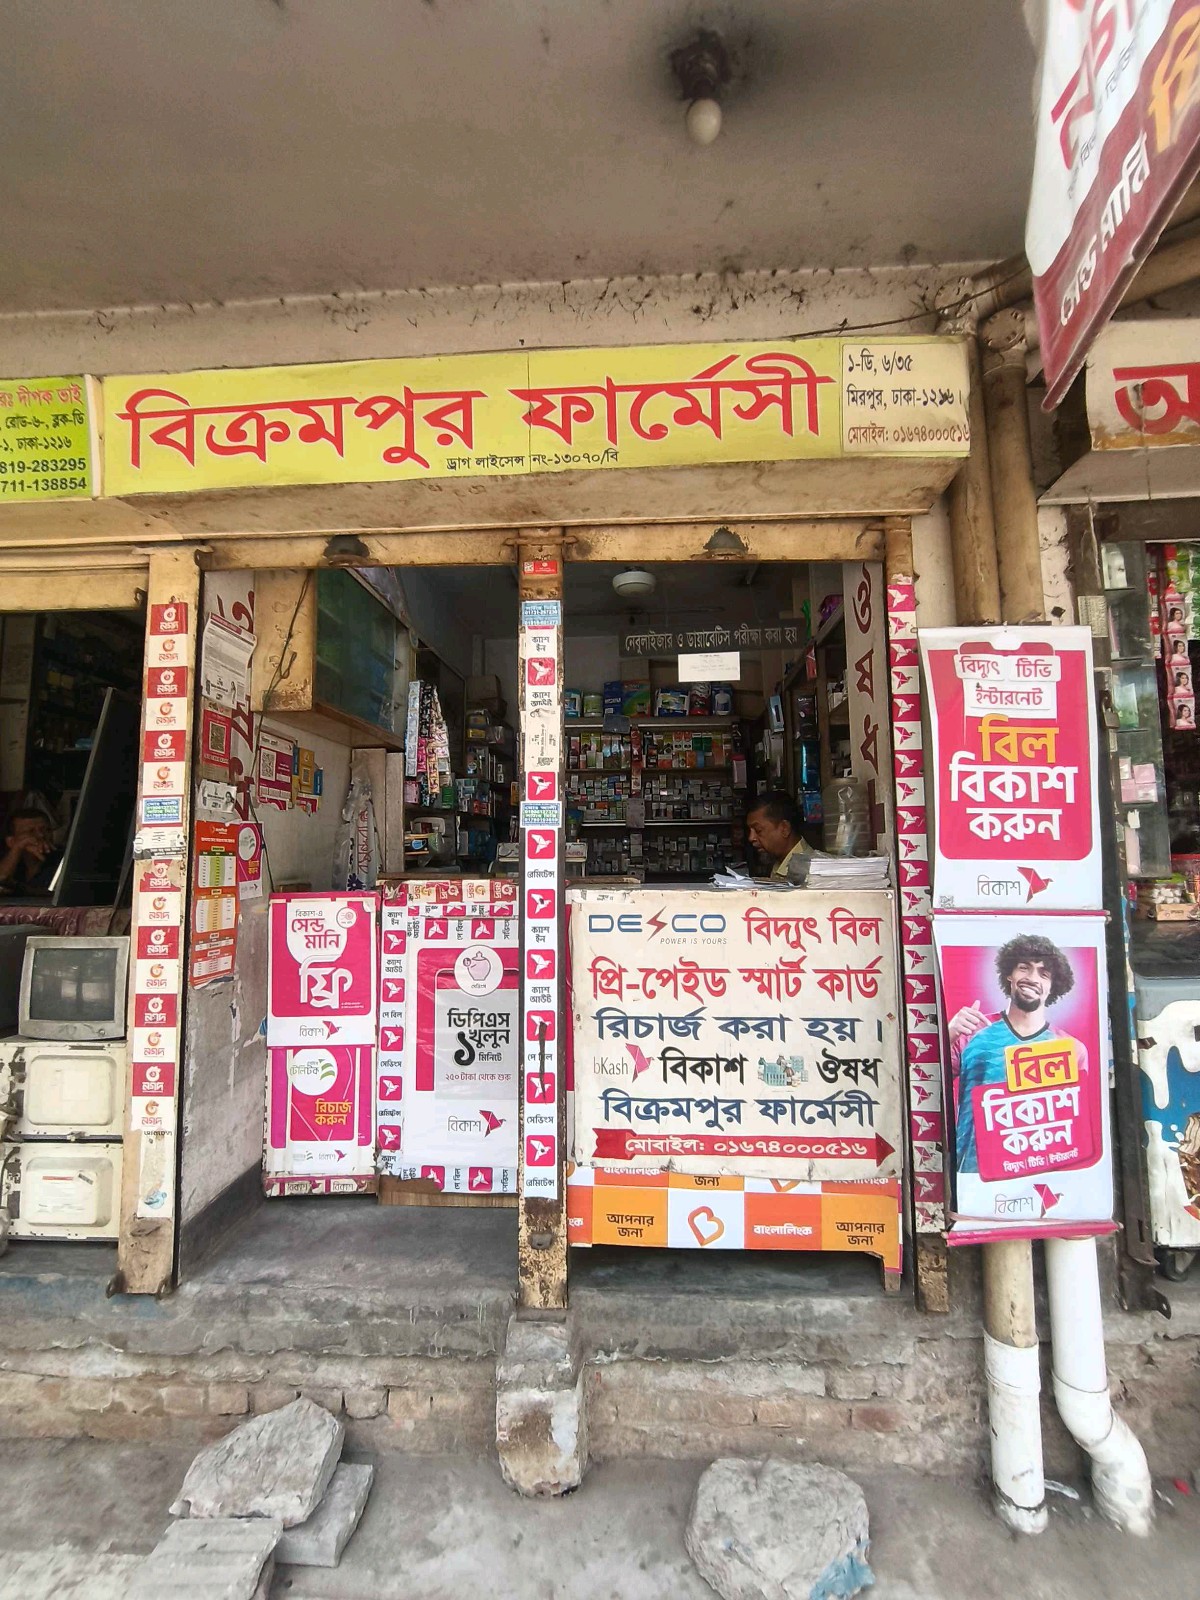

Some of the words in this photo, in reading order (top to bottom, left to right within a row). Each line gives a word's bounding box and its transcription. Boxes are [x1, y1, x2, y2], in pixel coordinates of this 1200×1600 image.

[847, 383, 887, 410] মিরপুর,
[116, 386, 488, 469] বিক্রমপুর
[509, 353, 836, 446] ফার্মেসী
[446, 457, 471, 471] ড্রাগ
[475, 454, 525, 470] লাইসেন্স
[625, 630, 673, 655] নেবুলাইজার
[677, 635, 684, 648] ও
[686, 625, 730, 649] ডায়াবেটিস
[734, 623, 761, 647] পরীক্ষা
[765, 628, 782, 644] করা
[785, 627, 797, 644] হয়
[959, 656, 1001, 679] বিদ্যুৎ
[1015, 657, 1053, 678] টিভি
[975, 686, 1044, 706] ইন্টারনেট
[977, 714, 1060, 763] বিল
[948, 751, 1079, 804] বিকাশ
[966, 807, 1062, 843] করুন
[976, 874, 1021, 896] বিকাশ
[292, 918, 325, 933] সেন্ড
[742, 907, 822, 952] বিদ্যুৎ
[826, 907, 883, 945] বিল
[304, 929, 341, 949] মানি
[535, 934, 546, 943] ইন
[660, 937, 688, 945] POWER
[691, 937, 697, 945] IS
[701, 937, 727, 945] YOURS
[299, 954, 353, 1009] ফ্রি
[587, 955, 730, 1005] প্রি-পেইড
[738, 955, 808, 1003] স্মার্ট
[813, 955, 883, 1004] কার্ড
[529, 994, 552, 1003] আউট
[447, 1008, 511, 1028] ডিপিএস
[591, 1006, 708, 1041] রিচার্জ
[712, 1013, 793, 1043] করা
[800, 1016, 864, 1045] হয়
[299, 1023, 324, 1037] বিকাশ
[469, 1028, 511, 1049] খুলুন
[453, 1030, 476, 1066] ১
[478, 1051, 502, 1062] মিনিটে
[593, 1056, 629, 1075] bKash
[657, 1046, 749, 1085] বিকাশ
[815, 1048, 883, 1087] ঔষধ
[1010, 1047, 1072, 1087] বিল
[315, 1099, 353, 1113] রিচার্জ
[599, 1088, 747, 1131] বিক্রমপুর
[755, 1090, 881, 1127] ফার্মেসী
[981, 1086, 1081, 1132] বিকাশ
[314, 1113, 347, 1126] করুন
[447, 1115, 482, 1132] বিকাশ
[526, 1114, 554, 1124] সেভিংস
[625, 1135, 705, 1154] মোবাইল:
[714, 1140, 868, 1156] ০১৬৭৪০০০৫১৬
[1000, 1119, 1073, 1155] করুন
[694, 1175, 720, 1188] জন্য
[994, 1194, 1034, 1215] বিকাশ
[606, 1213, 654, 1227] আপনার
[753, 1223, 813, 1236] বাংলালিংক
[835, 1221, 885, 1235] আপনার
[618, 1226, 643, 1239] জন্য
[847, 1233, 874, 1246] জন্য
